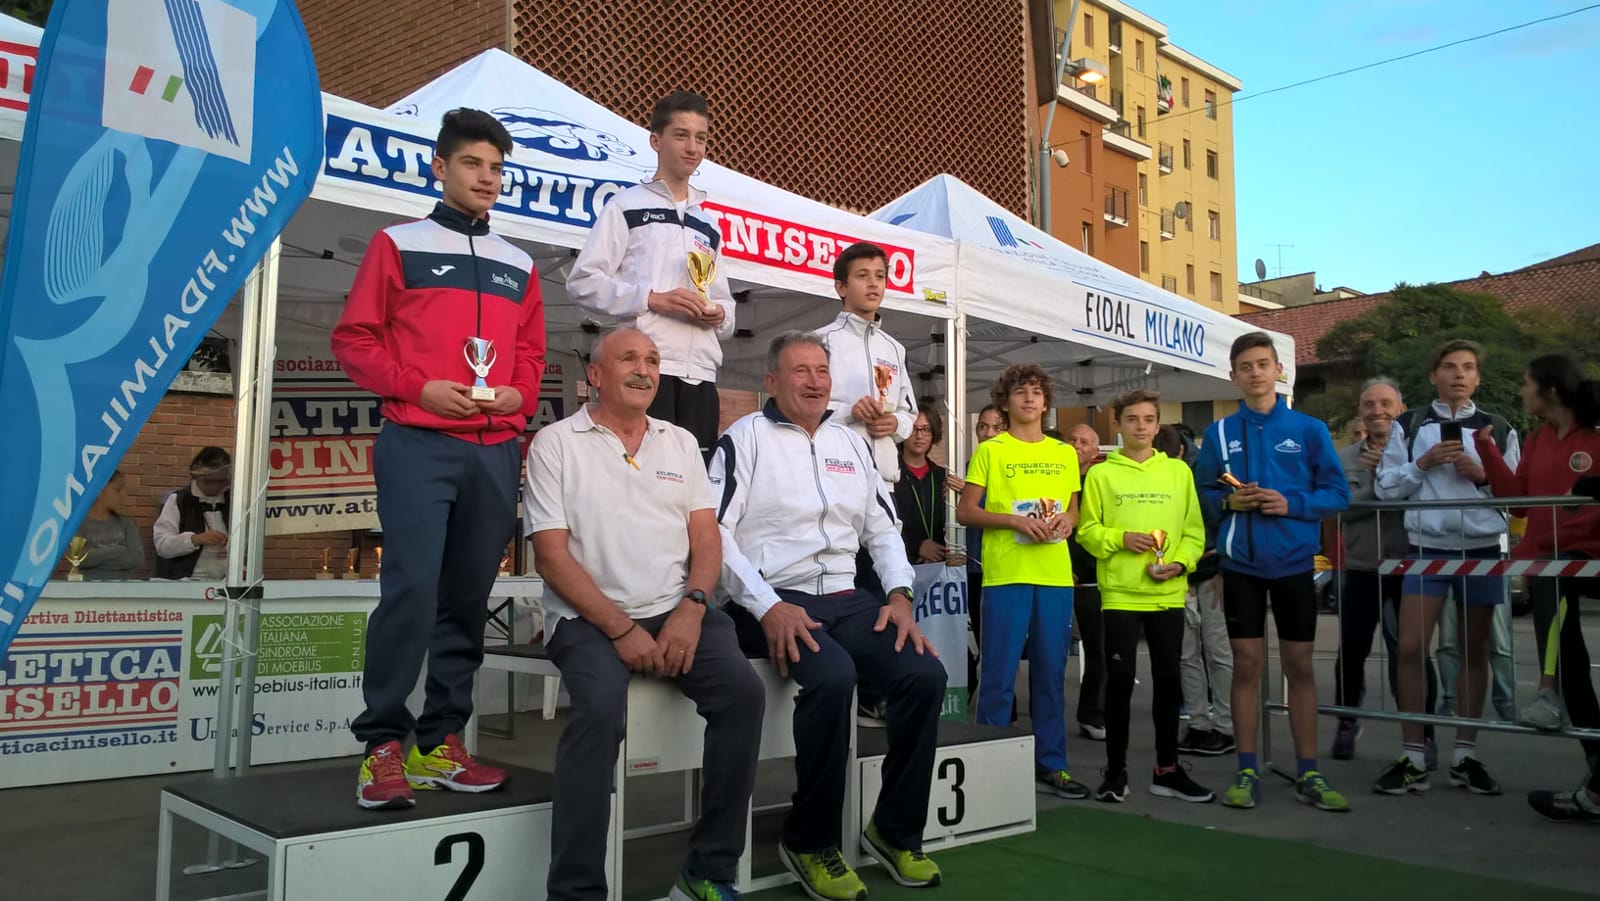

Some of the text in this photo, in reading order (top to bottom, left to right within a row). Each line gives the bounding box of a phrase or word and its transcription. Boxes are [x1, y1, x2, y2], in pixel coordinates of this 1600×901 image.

[1086, 291, 1206, 357] FIDAL MILANO
[22, 609, 184, 625] ortiva Dilettantistica
[261, 615, 345, 628] ASSOCIAZIONE
[259, 631, 309, 643] ITALIANA
[351, 618, 363, 670] ONLUS
[259, 646, 319, 659] SINDROME
[257, 660, 322, 674] DI MOEBIUS
[0, 681, 179, 721] ISELLO
[0, 730, 178, 755] ticacinisello.it
[937, 757, 967, 826] 3
[434, 832, 486, 901] 2
